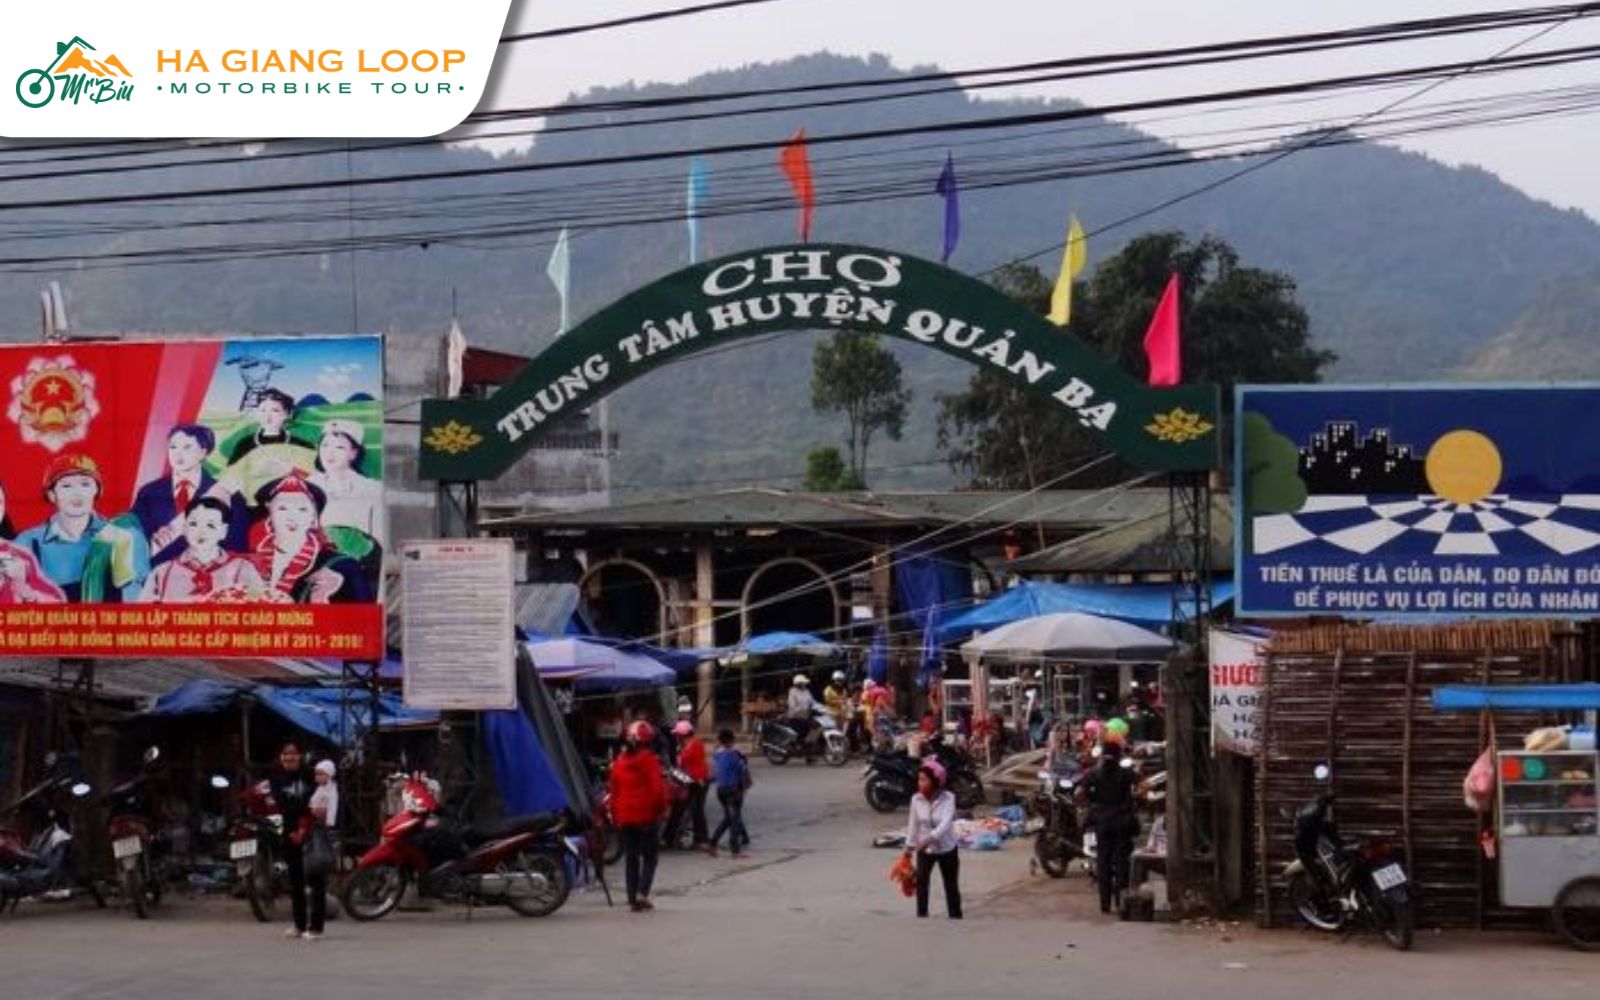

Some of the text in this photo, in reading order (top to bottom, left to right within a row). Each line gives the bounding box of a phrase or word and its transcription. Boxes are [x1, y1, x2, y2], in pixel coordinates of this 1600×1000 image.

[702, 251, 902, 296] CHỢ
[496, 288, 1117, 442] TRUNG TÂM HUYỆN QUẢN BẠ
[1309, 562, 1360, 583] THUẾ
[1364, 562, 1388, 584] LÀ
[1393, 560, 1433, 584] CỦA
[1493, 566, 1521, 585] DO
[1325, 590, 1379, 610] PHỤC
[1384, 591, 1409, 610] VỤ
[1416, 590, 1447, 612] LỢI
[1452, 588, 1487, 608] ÍCH
[1492, 586, 1534, 608] CỦA
[1539, 588, 1598, 609] NHÂN
